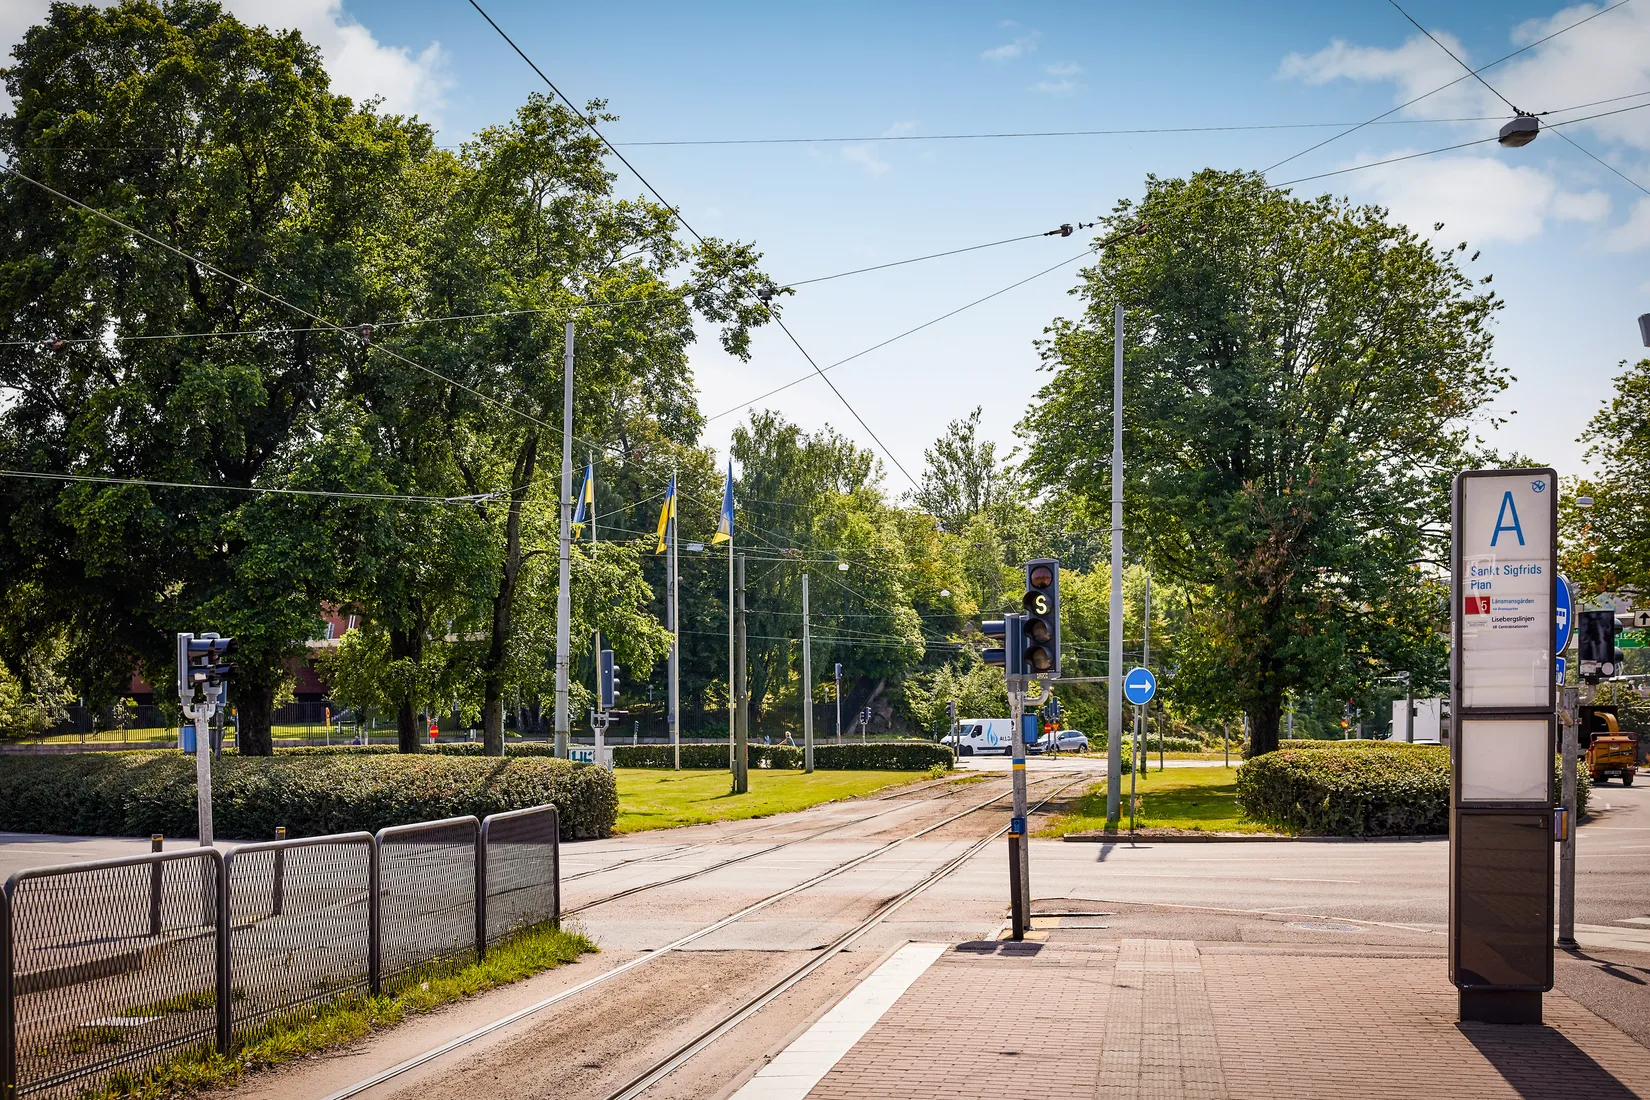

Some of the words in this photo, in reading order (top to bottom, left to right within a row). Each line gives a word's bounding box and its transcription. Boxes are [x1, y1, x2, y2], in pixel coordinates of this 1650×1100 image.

[1490, 491, 1525, 546] A
[1471, 565, 1500, 576] Sankt
[1503, 564, 1542, 577] Sigfrids
[1470, 580, 1492, 590] Plan
[1035, 595, 1048, 615] S
[1481, 600, 1488, 611] 5
[1492, 615, 1535, 623] Lisebergslinjen
